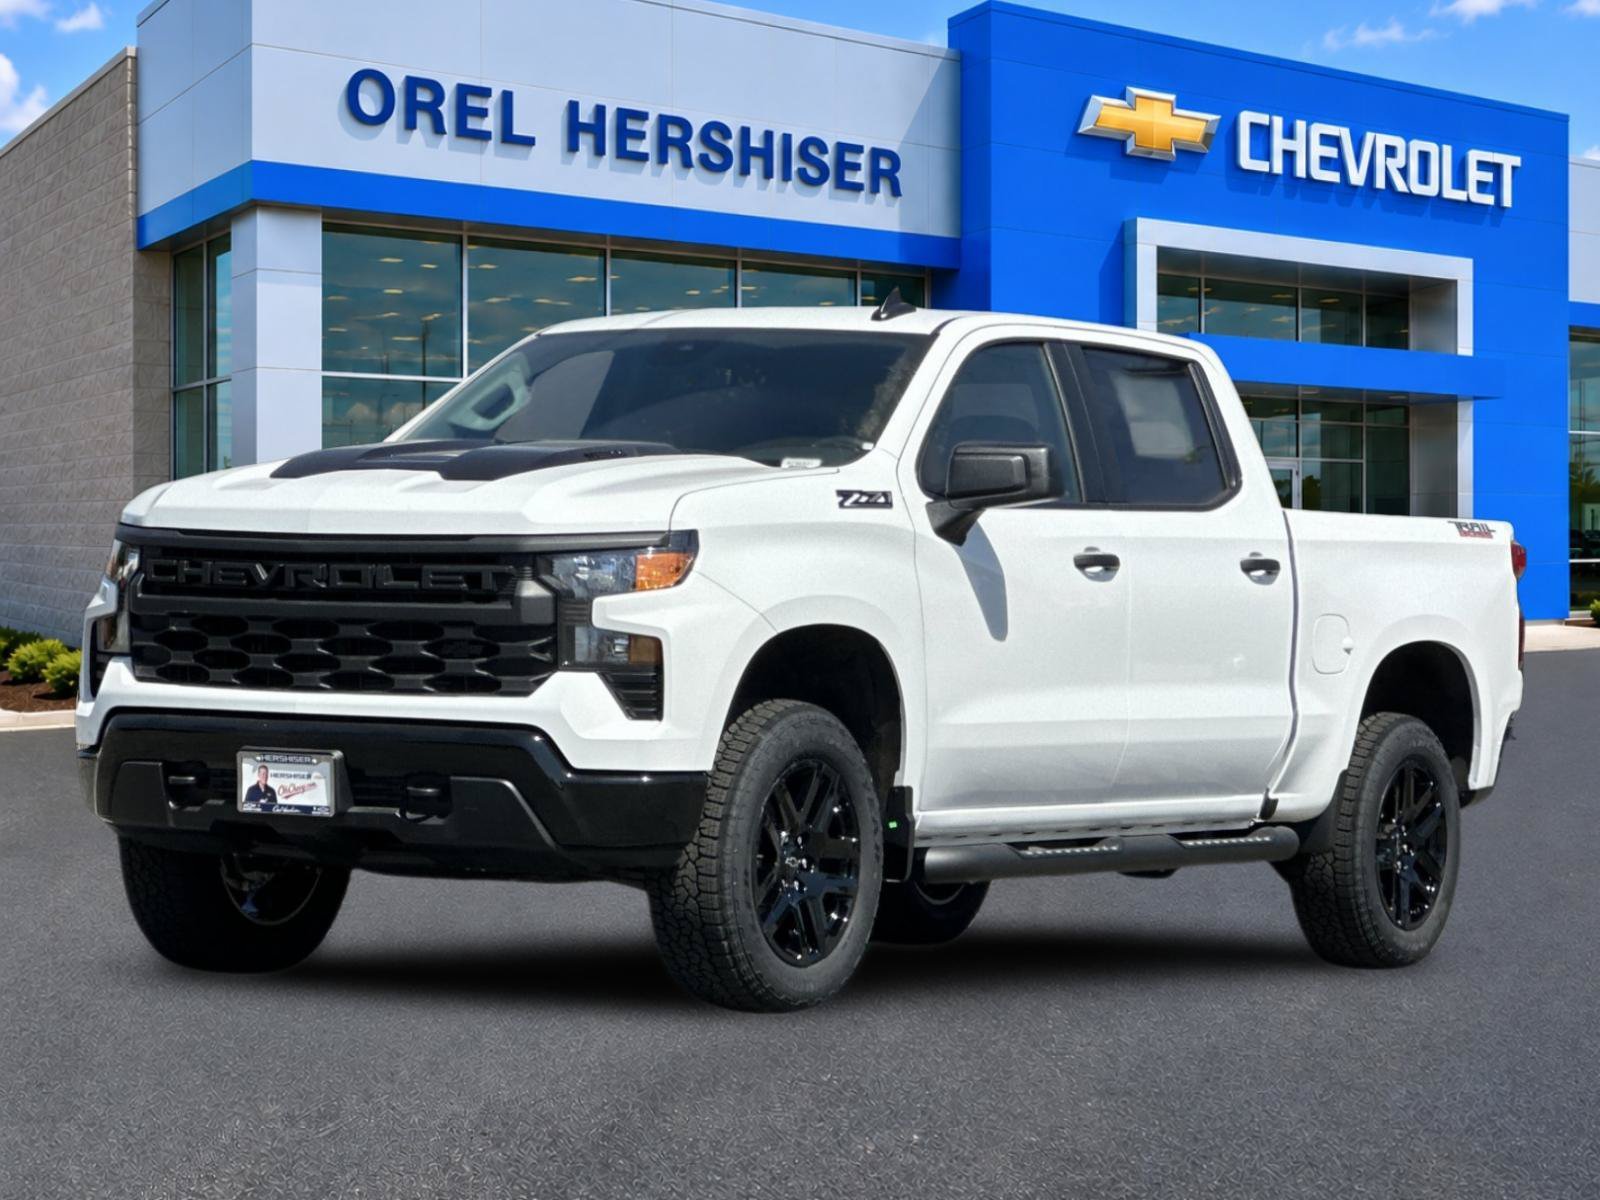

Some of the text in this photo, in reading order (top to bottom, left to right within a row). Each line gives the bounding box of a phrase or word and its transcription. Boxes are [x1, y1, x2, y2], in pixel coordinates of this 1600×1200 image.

[346, 68, 903, 198] OREL HERSHISER
[1236, 110, 1522, 208] CHEVROLET
[835, 489, 893, 509] Z71
[1448, 520, 1496, 533] TRAIL
[145, 558, 517, 593] CHEVROLET
[260, 754, 311, 763] HERSHISER
[270, 772, 312, 780] HERSHISER
